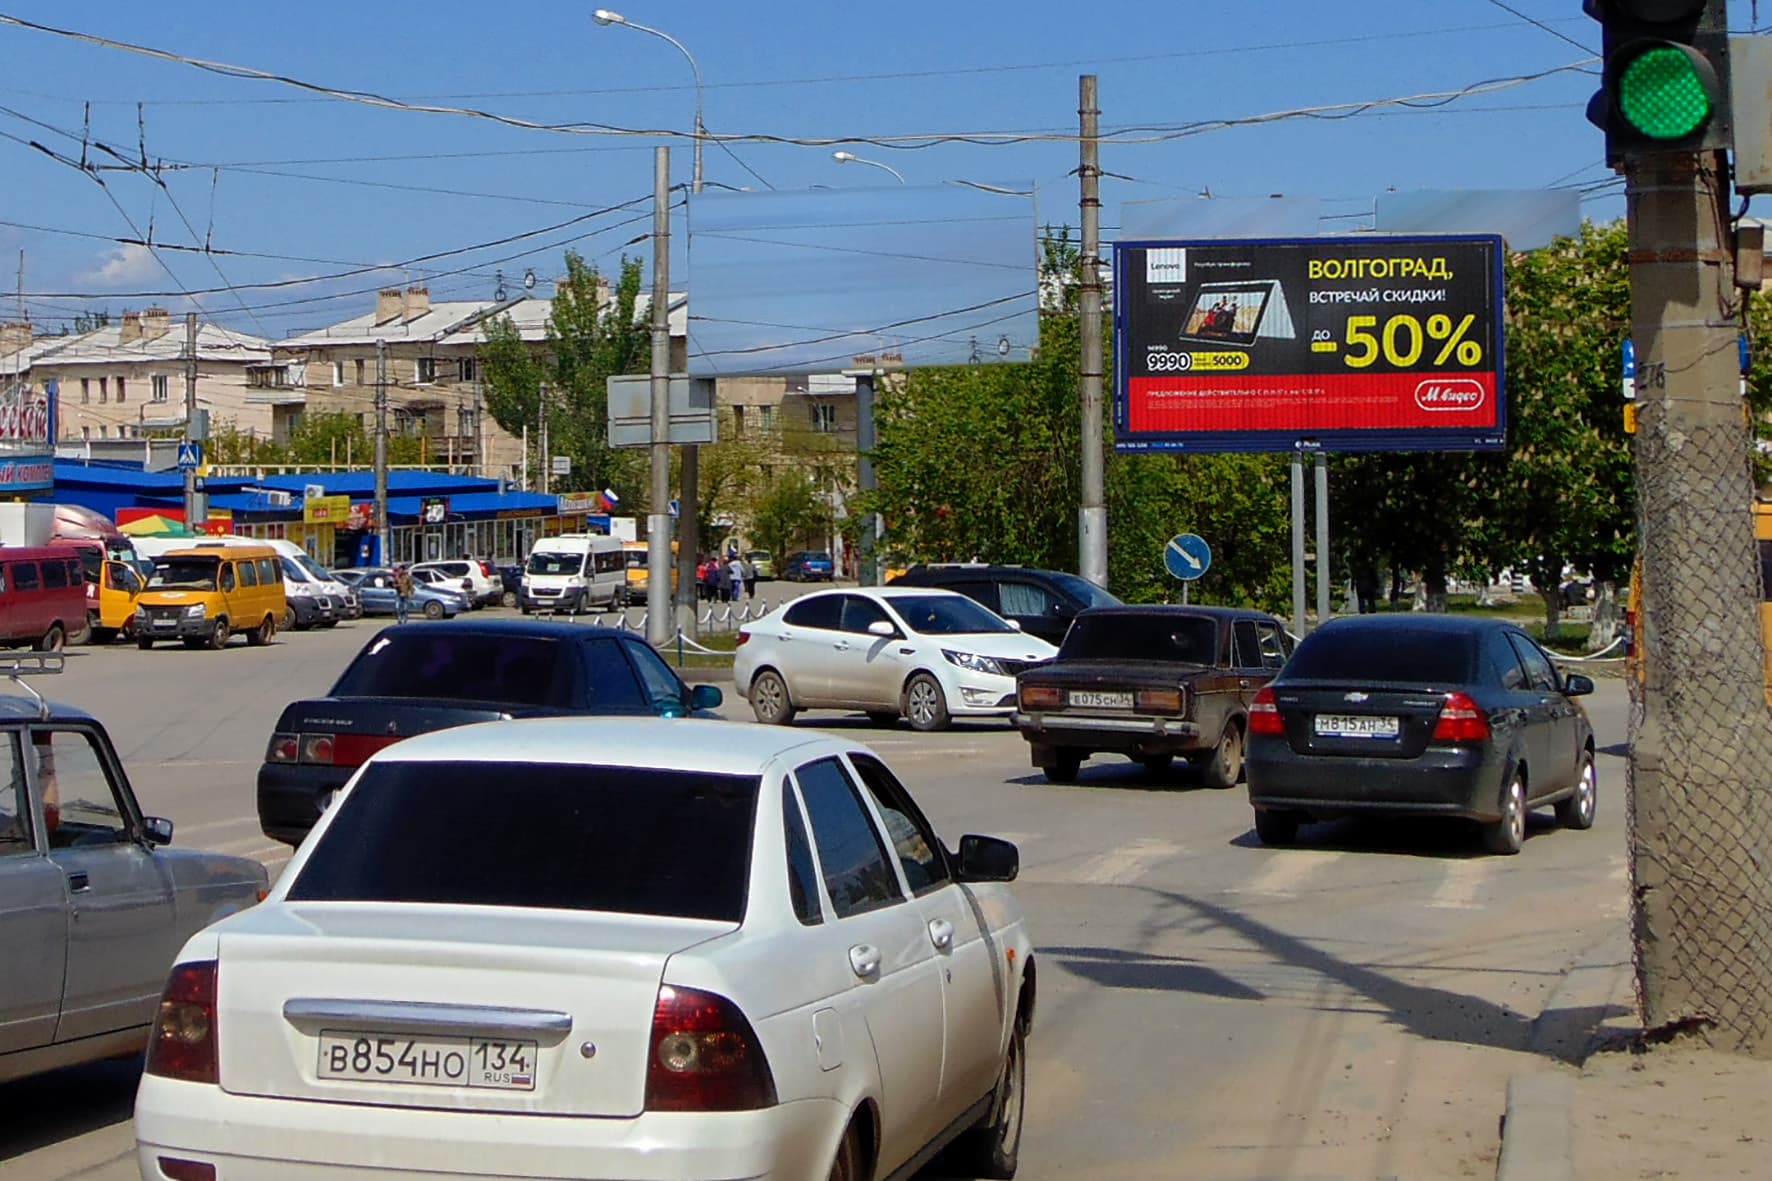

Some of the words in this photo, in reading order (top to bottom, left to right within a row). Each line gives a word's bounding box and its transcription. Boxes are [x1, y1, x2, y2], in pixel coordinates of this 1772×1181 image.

[1151, 262, 1180, 271] Lenovo
[1308, 257, 1454, 280] ВОЛГОГРАД,
[1309, 288, 1380, 304] ВСТРЕЧАЙ
[1382, 288, 1447, 302] СКИДКИ!
[1147, 353, 1191, 371] 9990
[1212, 355, 1242, 366] 5000
[475, 1042, 527, 1073] 134
[484, 1072, 511, 1084] RUS
